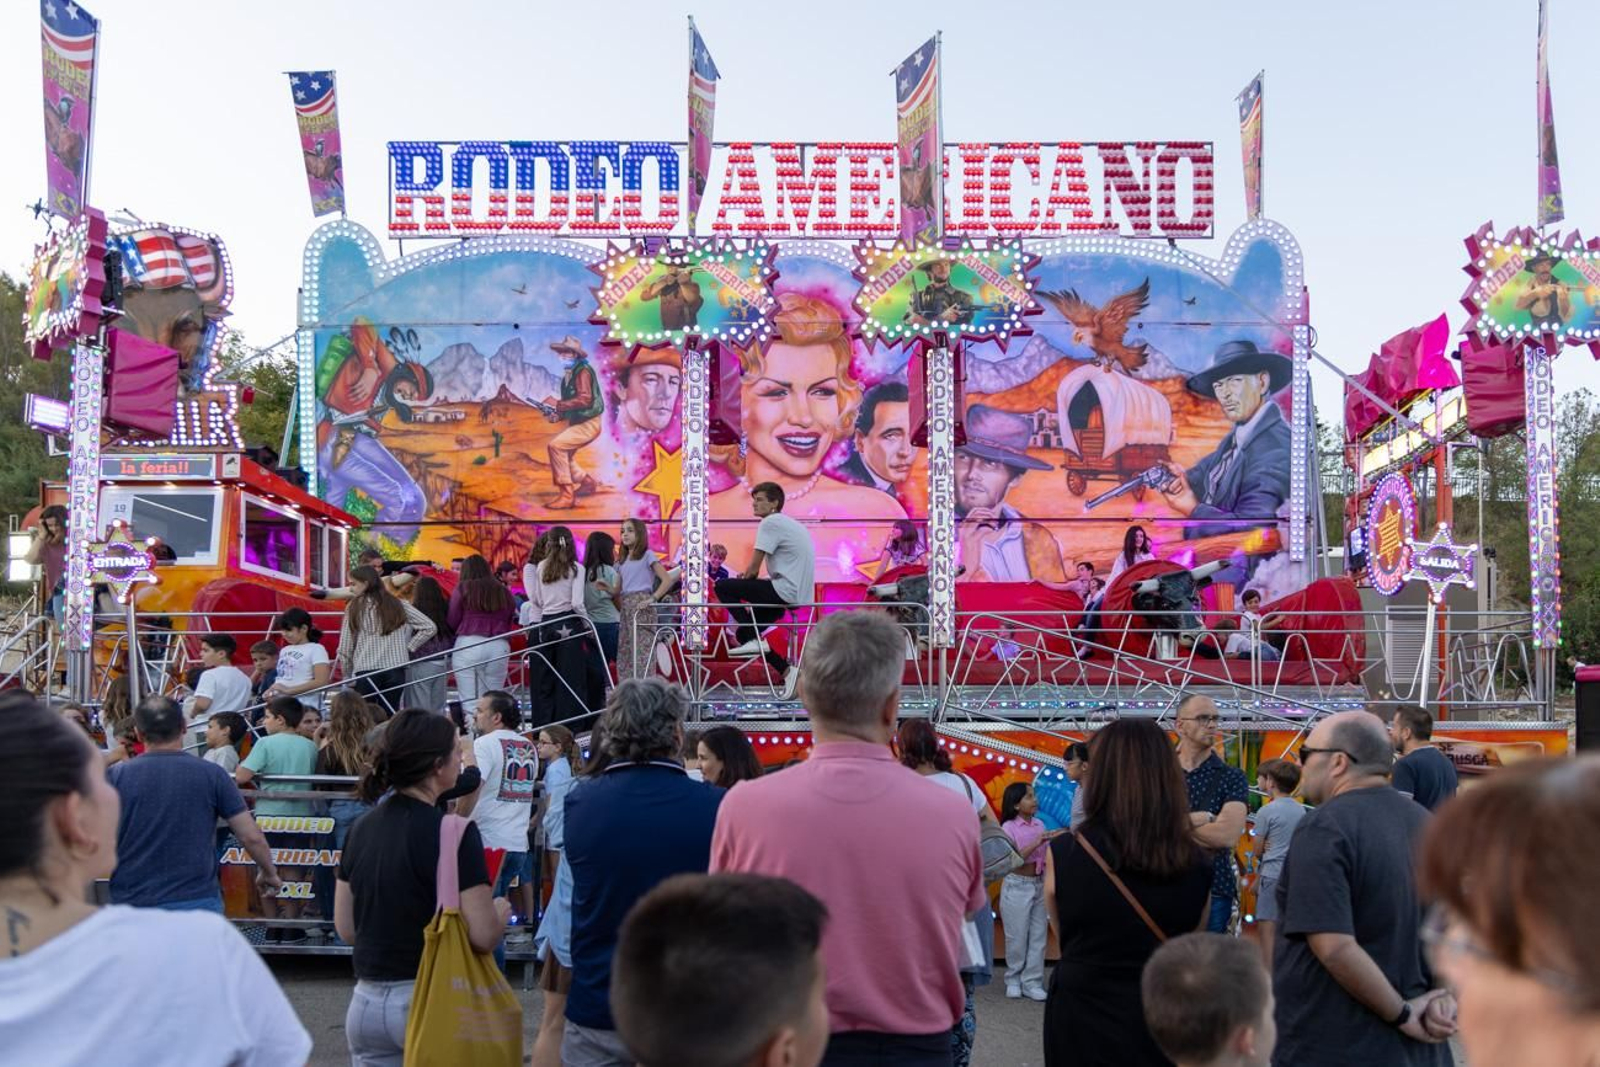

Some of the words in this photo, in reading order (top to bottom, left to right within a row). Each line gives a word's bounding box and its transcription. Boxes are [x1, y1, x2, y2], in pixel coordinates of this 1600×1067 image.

[387, 141, 680, 235] RODEO
[712, 142, 1212, 236] AMEICANO
[602, 262, 653, 309] RODEO
[863, 255, 914, 303] RODEO
[76, 350, 91, 432] RODEO
[688, 351, 701, 434] RODEO
[933, 351, 947, 433] RODEO
[1536, 347, 1550, 429] RODEO
[120, 461, 136, 474] la
[140, 461, 190, 474] feria!!
[687, 447, 702, 594] AMERICANO
[933, 446, 948, 592] AMERICANO
[1537, 443, 1555, 592] AMERICANO
[92, 555, 147, 568] ENTRADA
[1419, 556, 1460, 569] SALIDA
[934, 601, 948, 646] XXL
[256, 816, 336, 833] RODEO
